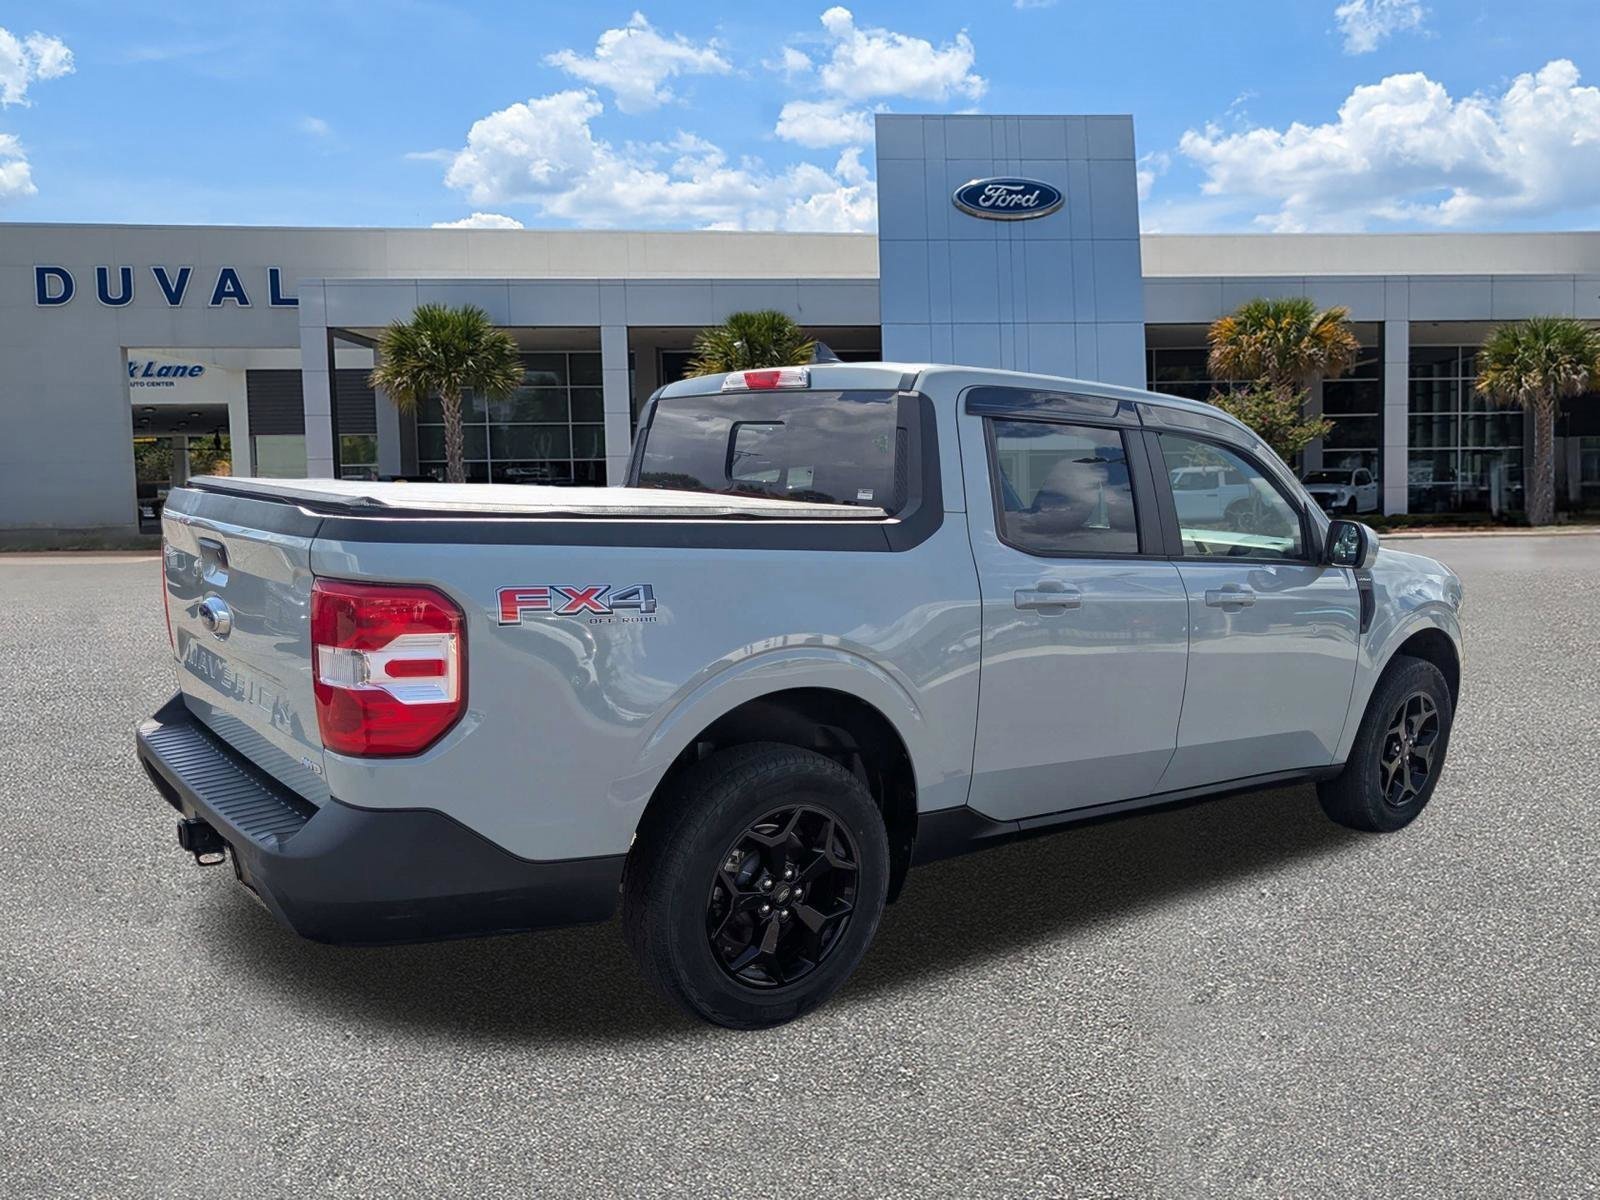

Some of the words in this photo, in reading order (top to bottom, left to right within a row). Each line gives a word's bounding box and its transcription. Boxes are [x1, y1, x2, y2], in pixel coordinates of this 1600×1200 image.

[979, 184, 1040, 207] Ford
[33, 265, 299, 308] DUVAL
[141, 361, 205, 378] Lane
[495, 584, 657, 626] FX4
